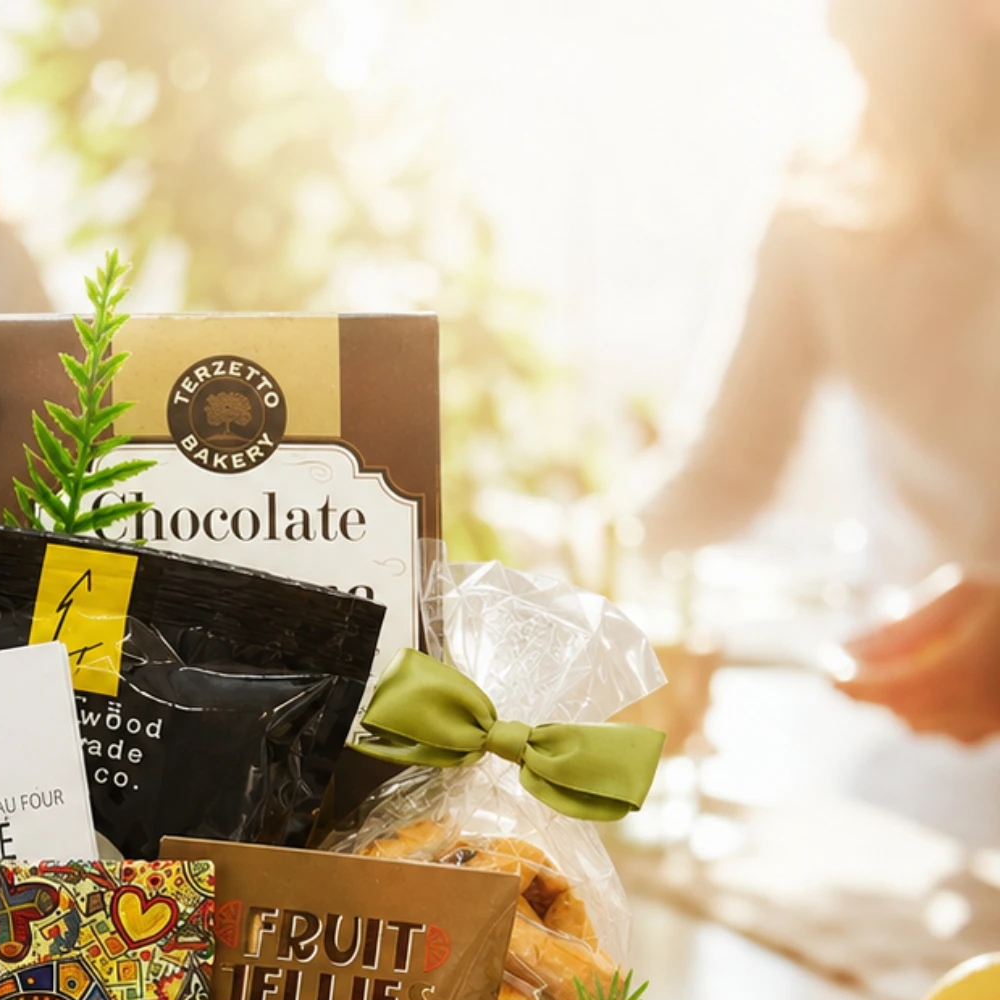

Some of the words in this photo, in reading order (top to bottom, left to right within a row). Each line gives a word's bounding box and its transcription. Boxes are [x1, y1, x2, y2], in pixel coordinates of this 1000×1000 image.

[173, 360, 280, 408] TERZETTO
[180, 432, 274, 469] BAKERY
[91, 490, 367, 542] Chocolate
[94, 767, 139, 790] co.
[21, 789, 64, 811] FOUR
[244, 905, 426, 973] FRUIT
